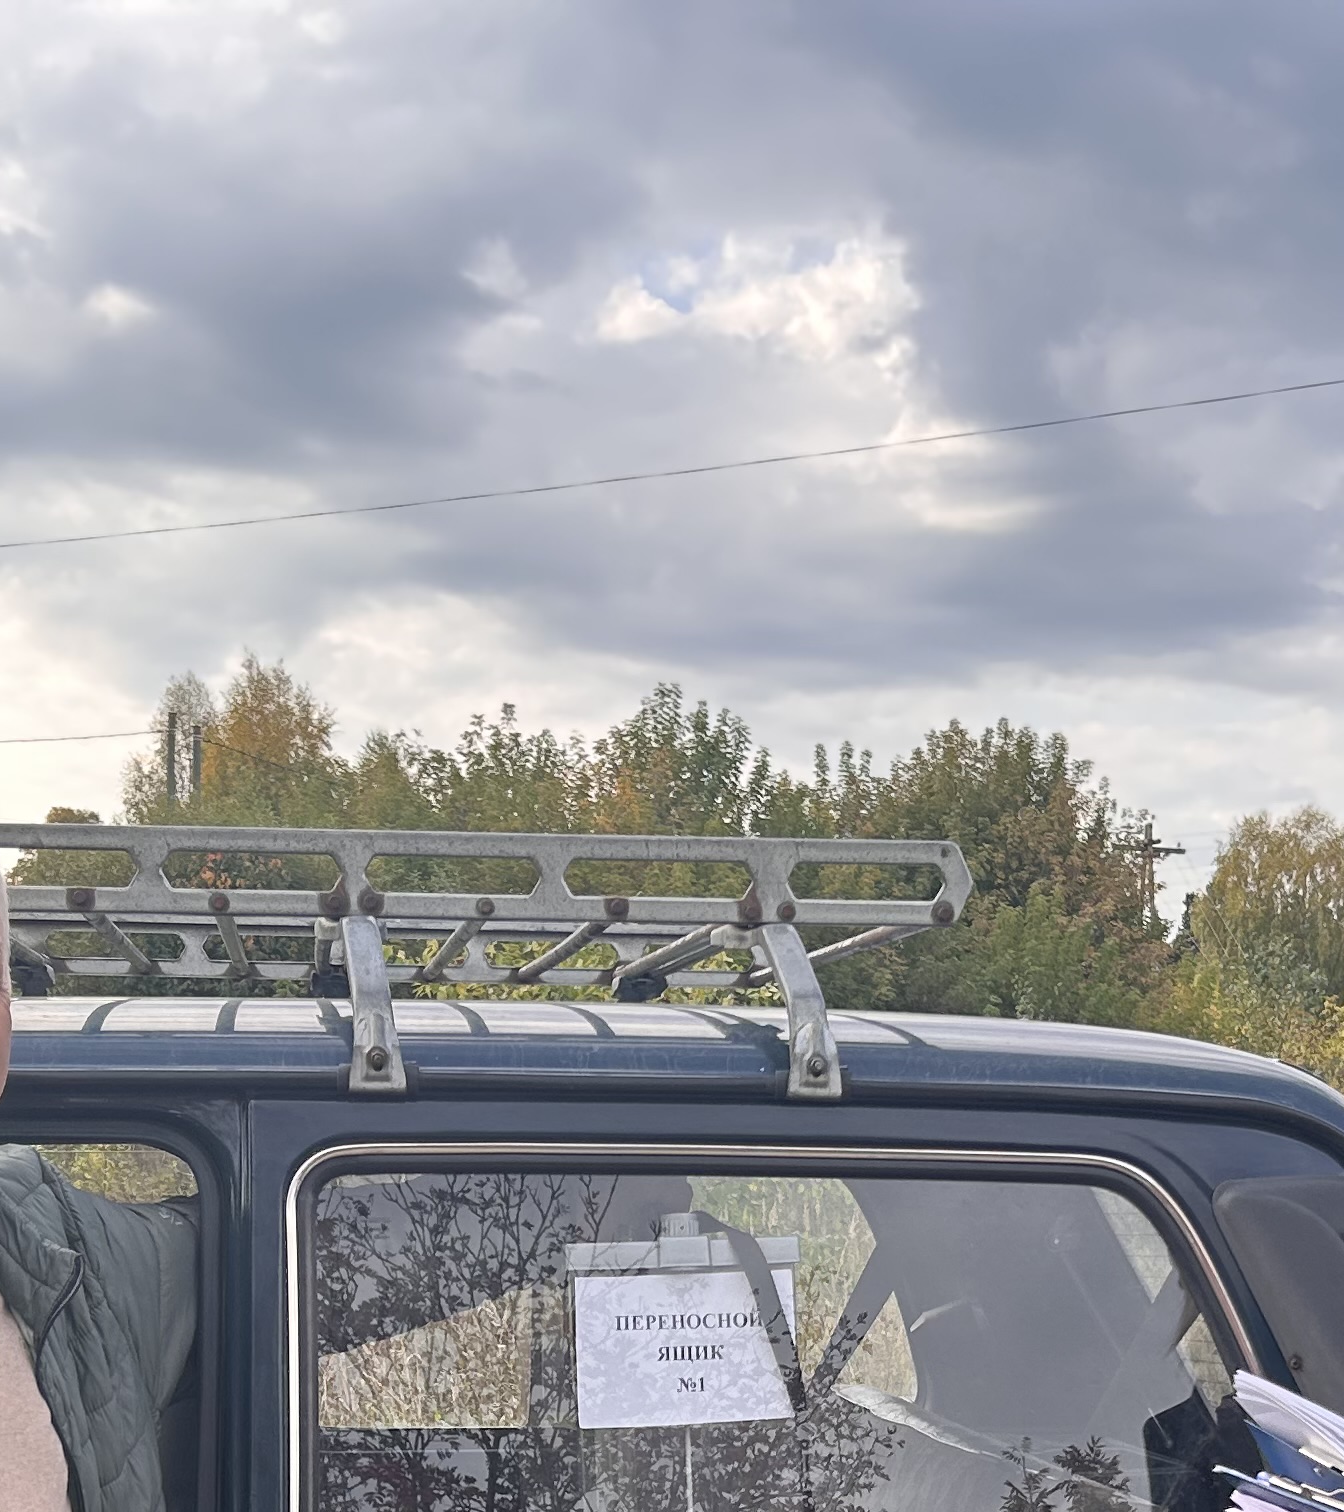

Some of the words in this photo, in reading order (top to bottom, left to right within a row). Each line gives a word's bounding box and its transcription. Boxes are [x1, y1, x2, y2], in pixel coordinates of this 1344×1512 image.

[615, 1310, 763, 1331] ПЕРЕНОСНОЙ
[657, 1344, 724, 1363] ЯЩИК
[676, 1377, 705, 1393] №1
